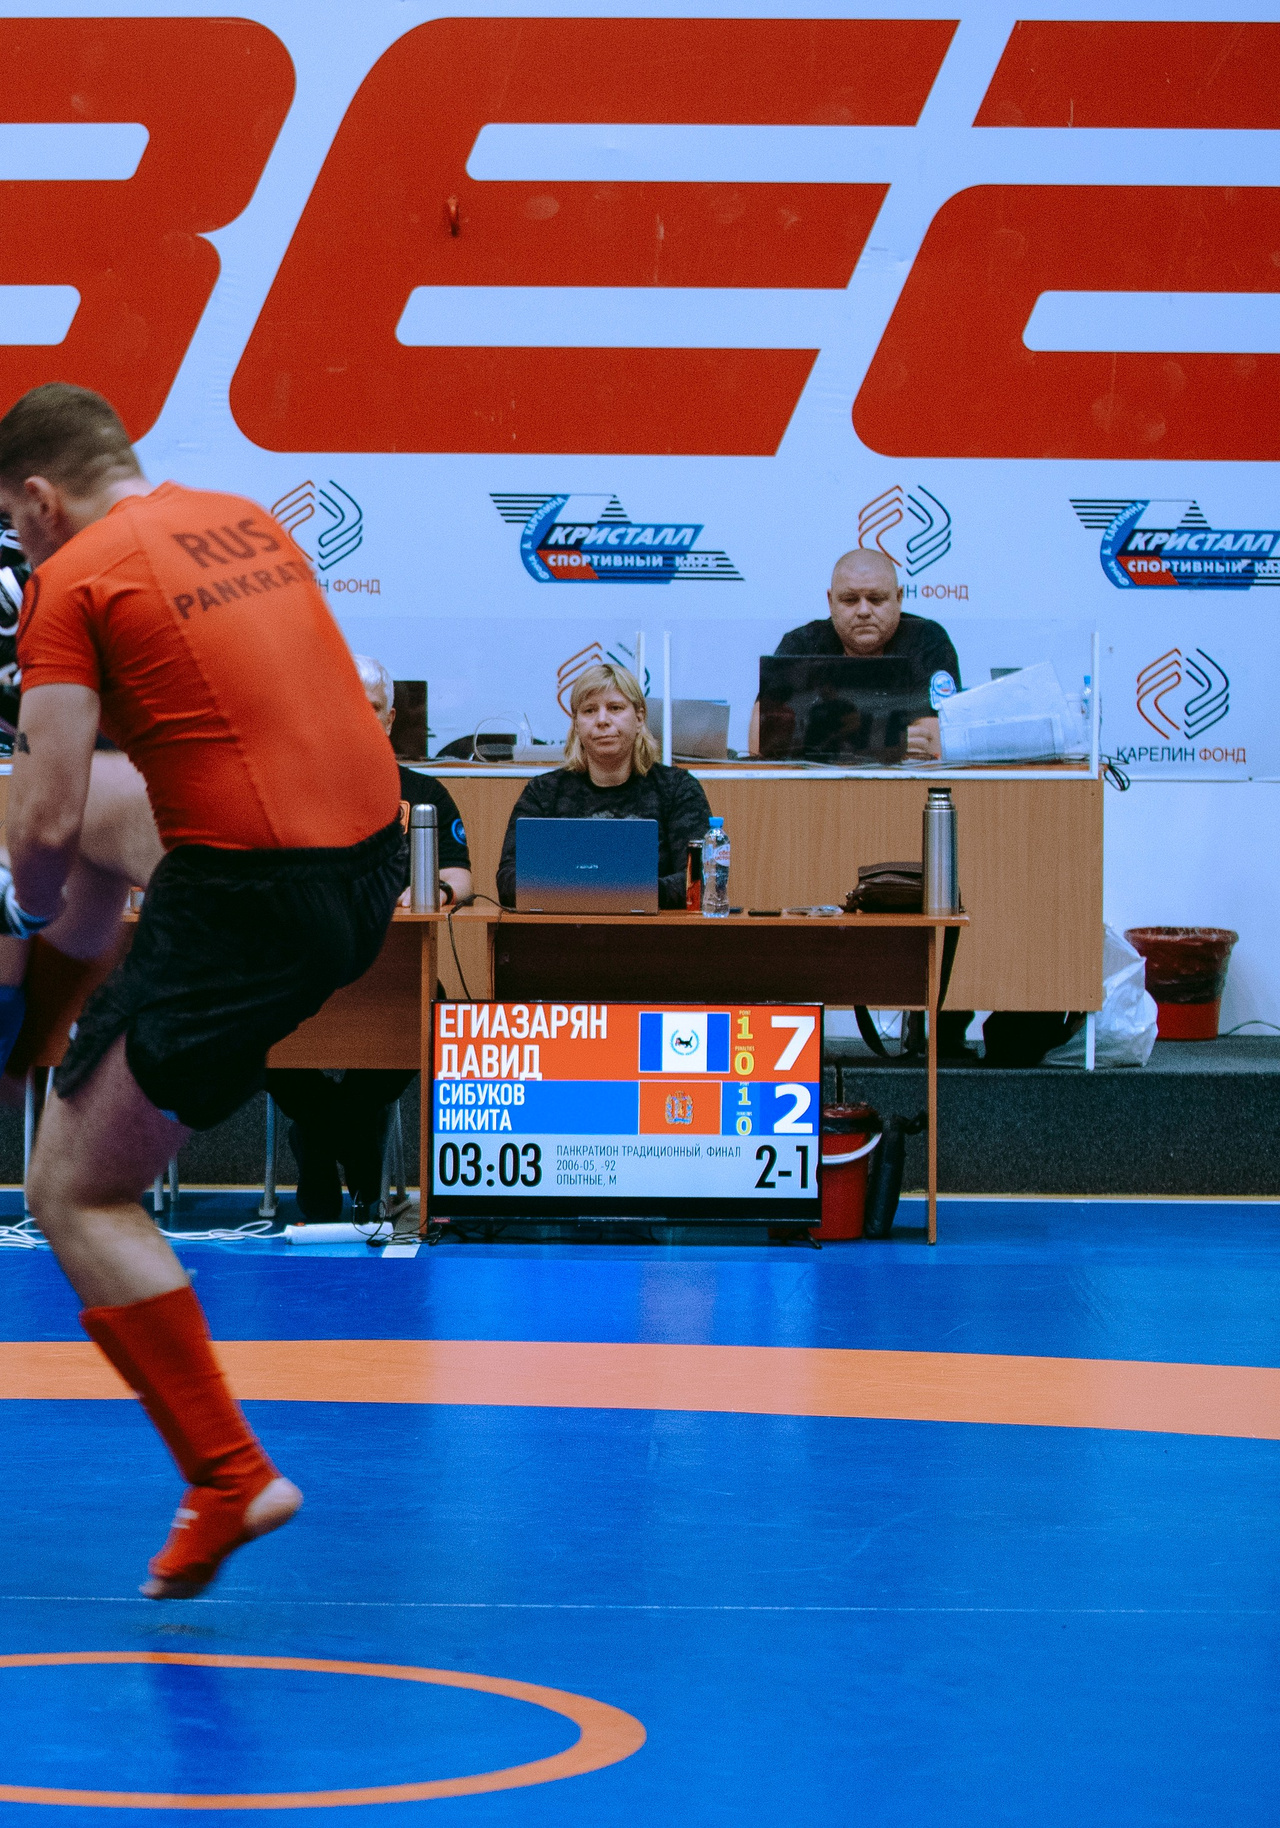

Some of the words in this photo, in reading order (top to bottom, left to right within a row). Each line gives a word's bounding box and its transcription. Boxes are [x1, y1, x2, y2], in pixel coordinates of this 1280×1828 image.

[525, 496, 565, 535] КАРЕЛИНА
[1104, 501, 1146, 541] КАРЕЛИНА
[172, 518, 281, 569] RUS
[548, 526, 696, 545] КРИСТАЛЛ
[1127, 532, 1274, 551] КРИСТАЛЛ
[548, 554, 663, 567] СПОРТИВНЫЙ
[1127, 560, 1242, 573] СПОРТИВНЫЙ
[332, 578, 381, 595] ФОНД
[921, 583, 969, 600] ФОНД
[1117, 746, 1196, 763] КАРЕЛИН
[1198, 746, 1247, 764] ФОНД
[439, 1005, 608, 1039] ЕГИАЗАРЯН
[737, 1016, 754, 1039] 1
[771, 1015, 816, 1071] 7
[437, 1045, 543, 1080] ДАВИД
[734, 1051, 755, 1076] 0
[438, 1083, 525, 1106] СИБУКОВ
[738, 1086, 752, 1106] 1
[773, 1083, 814, 1134] 2
[438, 1109, 512, 1131] НИКИТА
[736, 1116, 753, 1136] 0
[556, 1145, 619, 1157] ПАНКРАТИОН
[621, 1144, 704, 1159] ТРАДИЦИОННЫЙ,
[706, 1145, 741, 1158] ФИНАЛ
[438, 1141, 543, 1188] 03:03
[556, 1159, 598, 1173] 2006-05,
[600, 1160, 616, 1171] -92
[754, 1144, 809, 1189] 2-1
[556, 1173, 606, 1187] ОПЫТНЫЕ,
[608, 1174, 617, 1185] М
